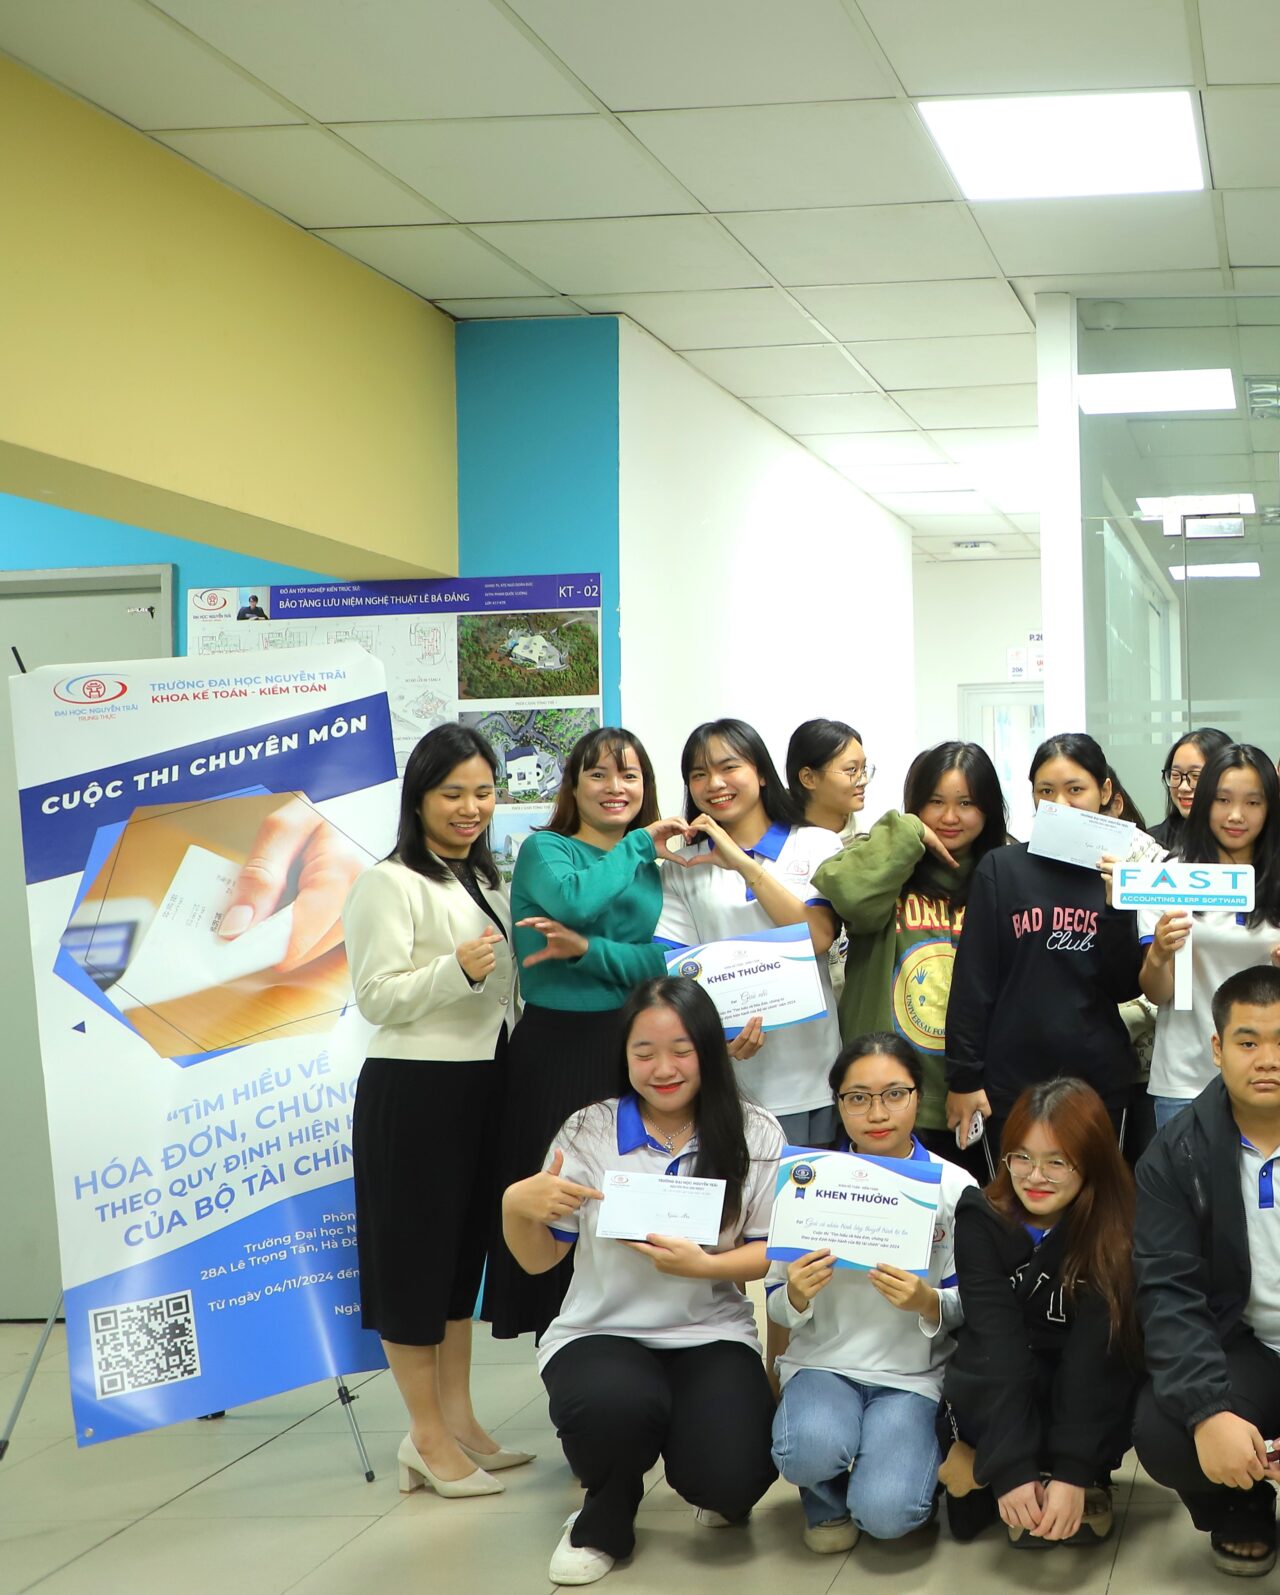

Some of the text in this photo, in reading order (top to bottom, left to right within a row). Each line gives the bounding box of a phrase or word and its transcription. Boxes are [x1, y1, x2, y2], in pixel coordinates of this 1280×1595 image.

[279, 598, 297, 609] BẢO
[298, 598, 321, 608] TÀNG
[322, 597, 340, 607] LƯU
[342, 596, 363, 607] NIỆM
[365, 595, 389, 606] NGHỆ
[390, 594, 418, 605] THUẬT
[420, 593, 429, 603] LÊ
[431, 592, 442, 603] BÁ
[559, 586, 574, 598] KT
[584, 585, 599, 597] 02
[151, 669, 346, 692] TRƯỜNG ĐẠI HỌC NGUYỄN TRÃI
[152, 693, 189, 704] KHOA
[193, 689, 209, 702] KẾ
[214, 688, 248, 700] TOÁN
[259, 682, 288, 696] KIỂM
[292, 684, 327, 694] TOÁN
[70, 708, 87, 716] HỌC
[90, 705, 121, 714] NGUYỄN
[41, 714, 367, 815] CUỘC THI CHUYÊN MÔN
[1120, 868, 1248, 890] FAST
[1012, 907, 1043, 939] BAD
[1046, 931, 1094, 952] Club
[706, 972, 736, 985] KHEN
[737, 961, 782, 978] THƯỞNG
[907, 994, 932, 1033] UNIVERSAL
[232, 1067, 292, 1106] HIỂU
[297, 1051, 331, 1080] VỀ
[74, 1155, 154, 1200] HÓA
[160, 1119, 247, 1171] ĐƠN,
[94, 1117, 340, 1223] THEO QUY ĐỊNH HIỆN
[123, 1208, 188, 1247] CỦA
[194, 1182, 236, 1221] BỘ
[241, 1161, 286, 1196] TÀI
[815, 1189, 899, 1206] KHEN THƯỞNG
[322, 1213, 357, 1223] Phòn
[244, 1234, 292, 1254] Trường
[295, 1230, 317, 1242] Đại
[320, 1227, 344, 1237] học
[200, 1238, 338, 1280] 28A Lê Trọng Tấn, Hà
[207, 1299, 225, 1312] Từ
[229, 1290, 261, 1307] ngày
[264, 1271, 334, 1296] 04/11/2024
